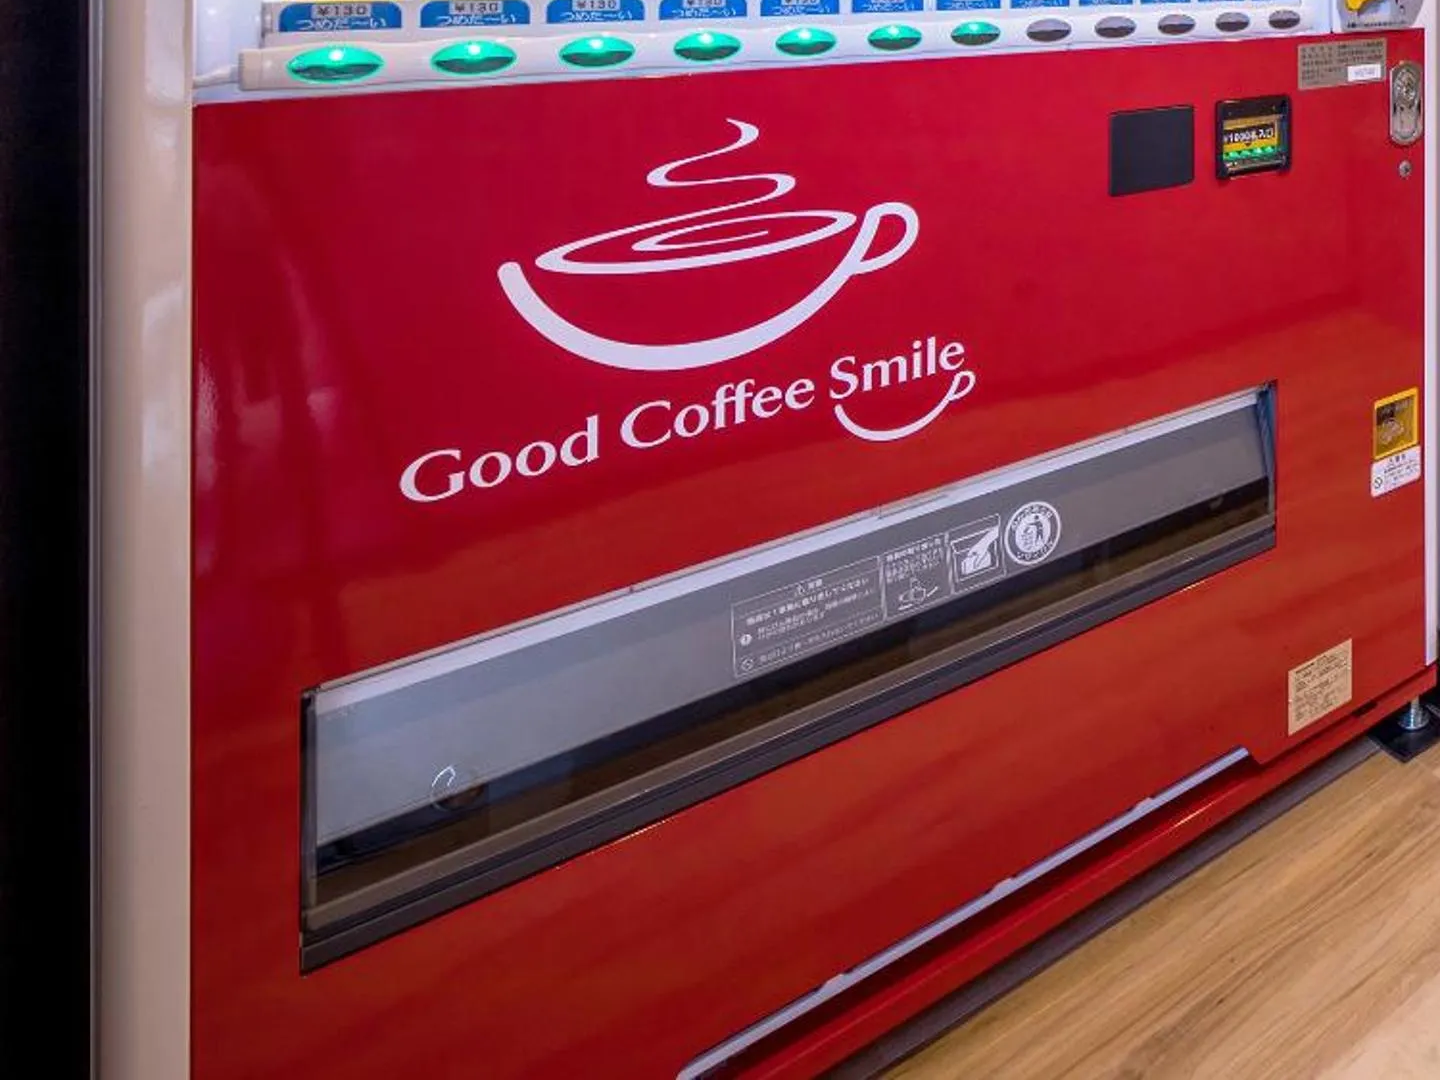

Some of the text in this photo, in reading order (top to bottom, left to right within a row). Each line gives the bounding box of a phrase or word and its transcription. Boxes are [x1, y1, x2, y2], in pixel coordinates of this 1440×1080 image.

[316, 4, 369, 17] ¥130
[454, 1, 499, 14] ¥130
[399, 335, 965, 503] Good Coffee Smile
